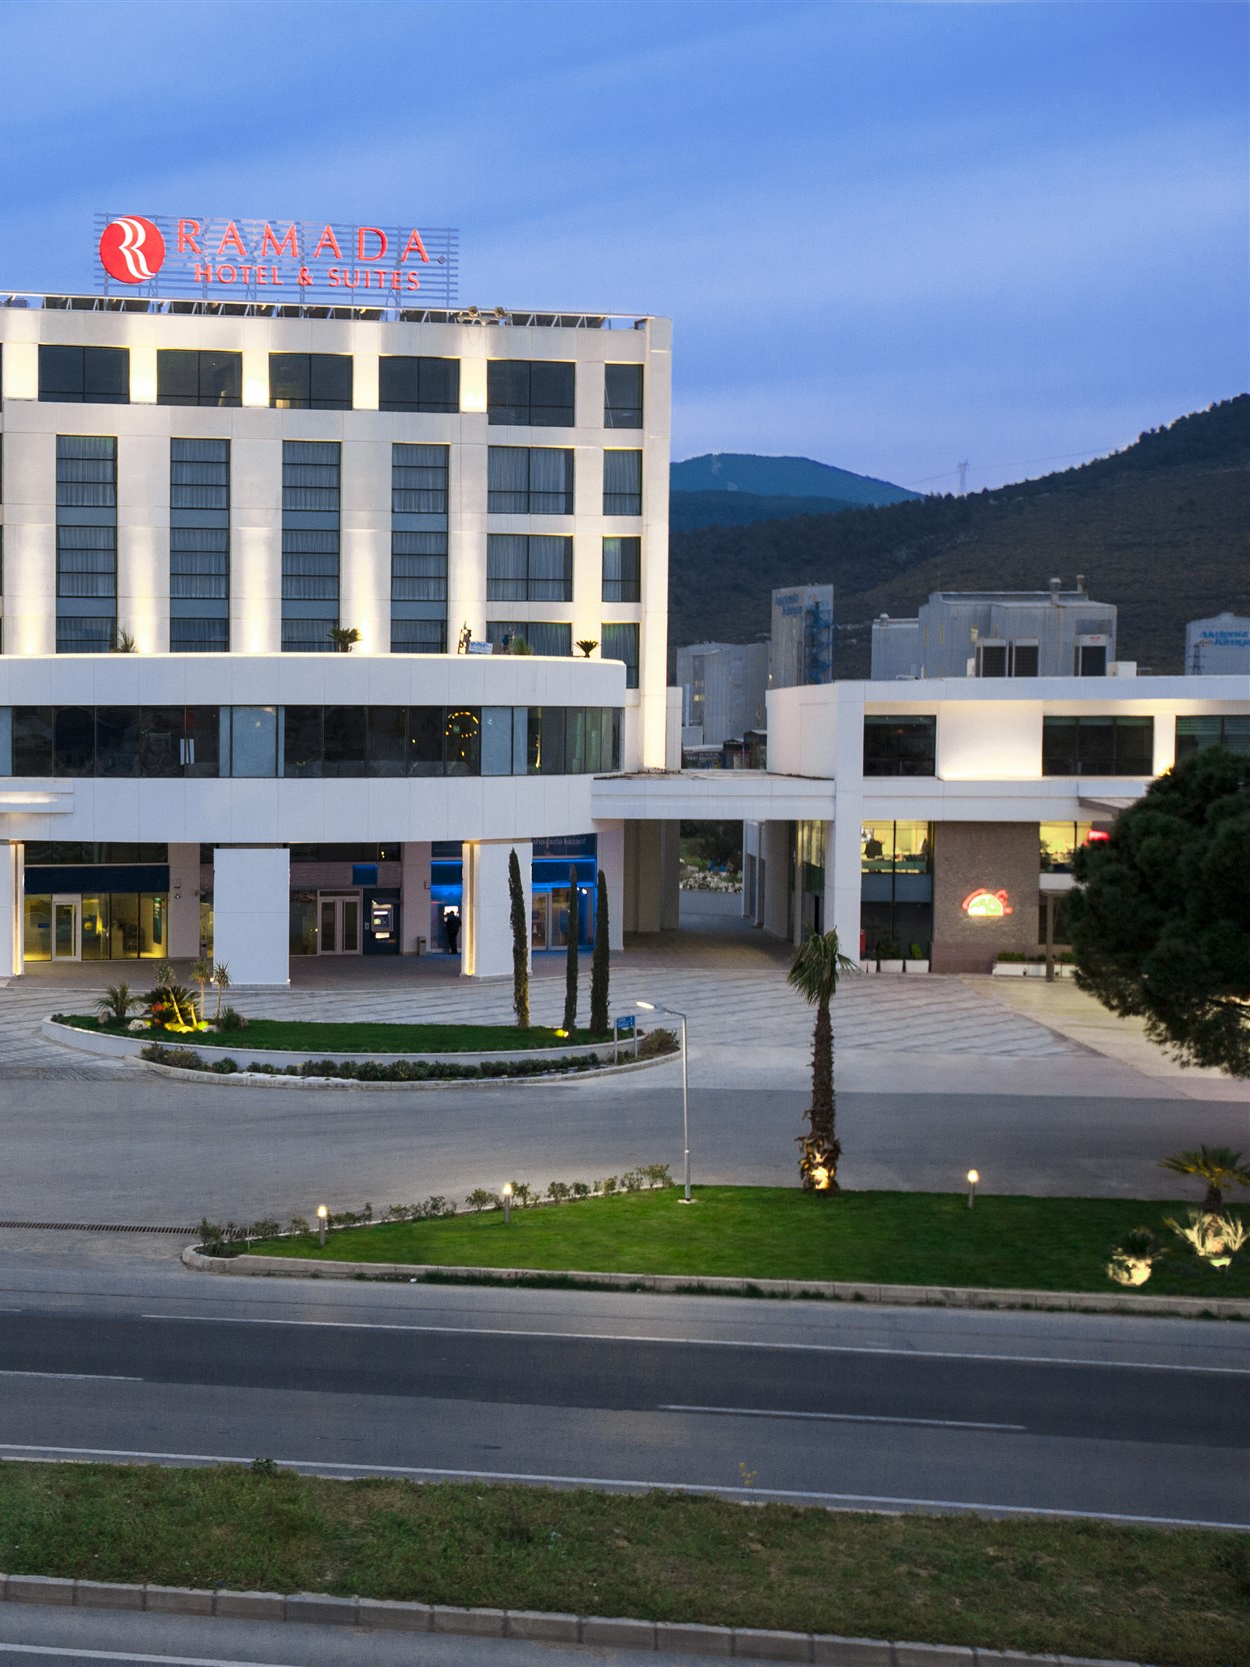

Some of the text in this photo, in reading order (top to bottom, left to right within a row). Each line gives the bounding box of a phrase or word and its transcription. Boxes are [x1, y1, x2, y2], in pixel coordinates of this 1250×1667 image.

[177, 219, 430, 263] RAMADA
[194, 263, 421, 291] HOTEL & SUITES
